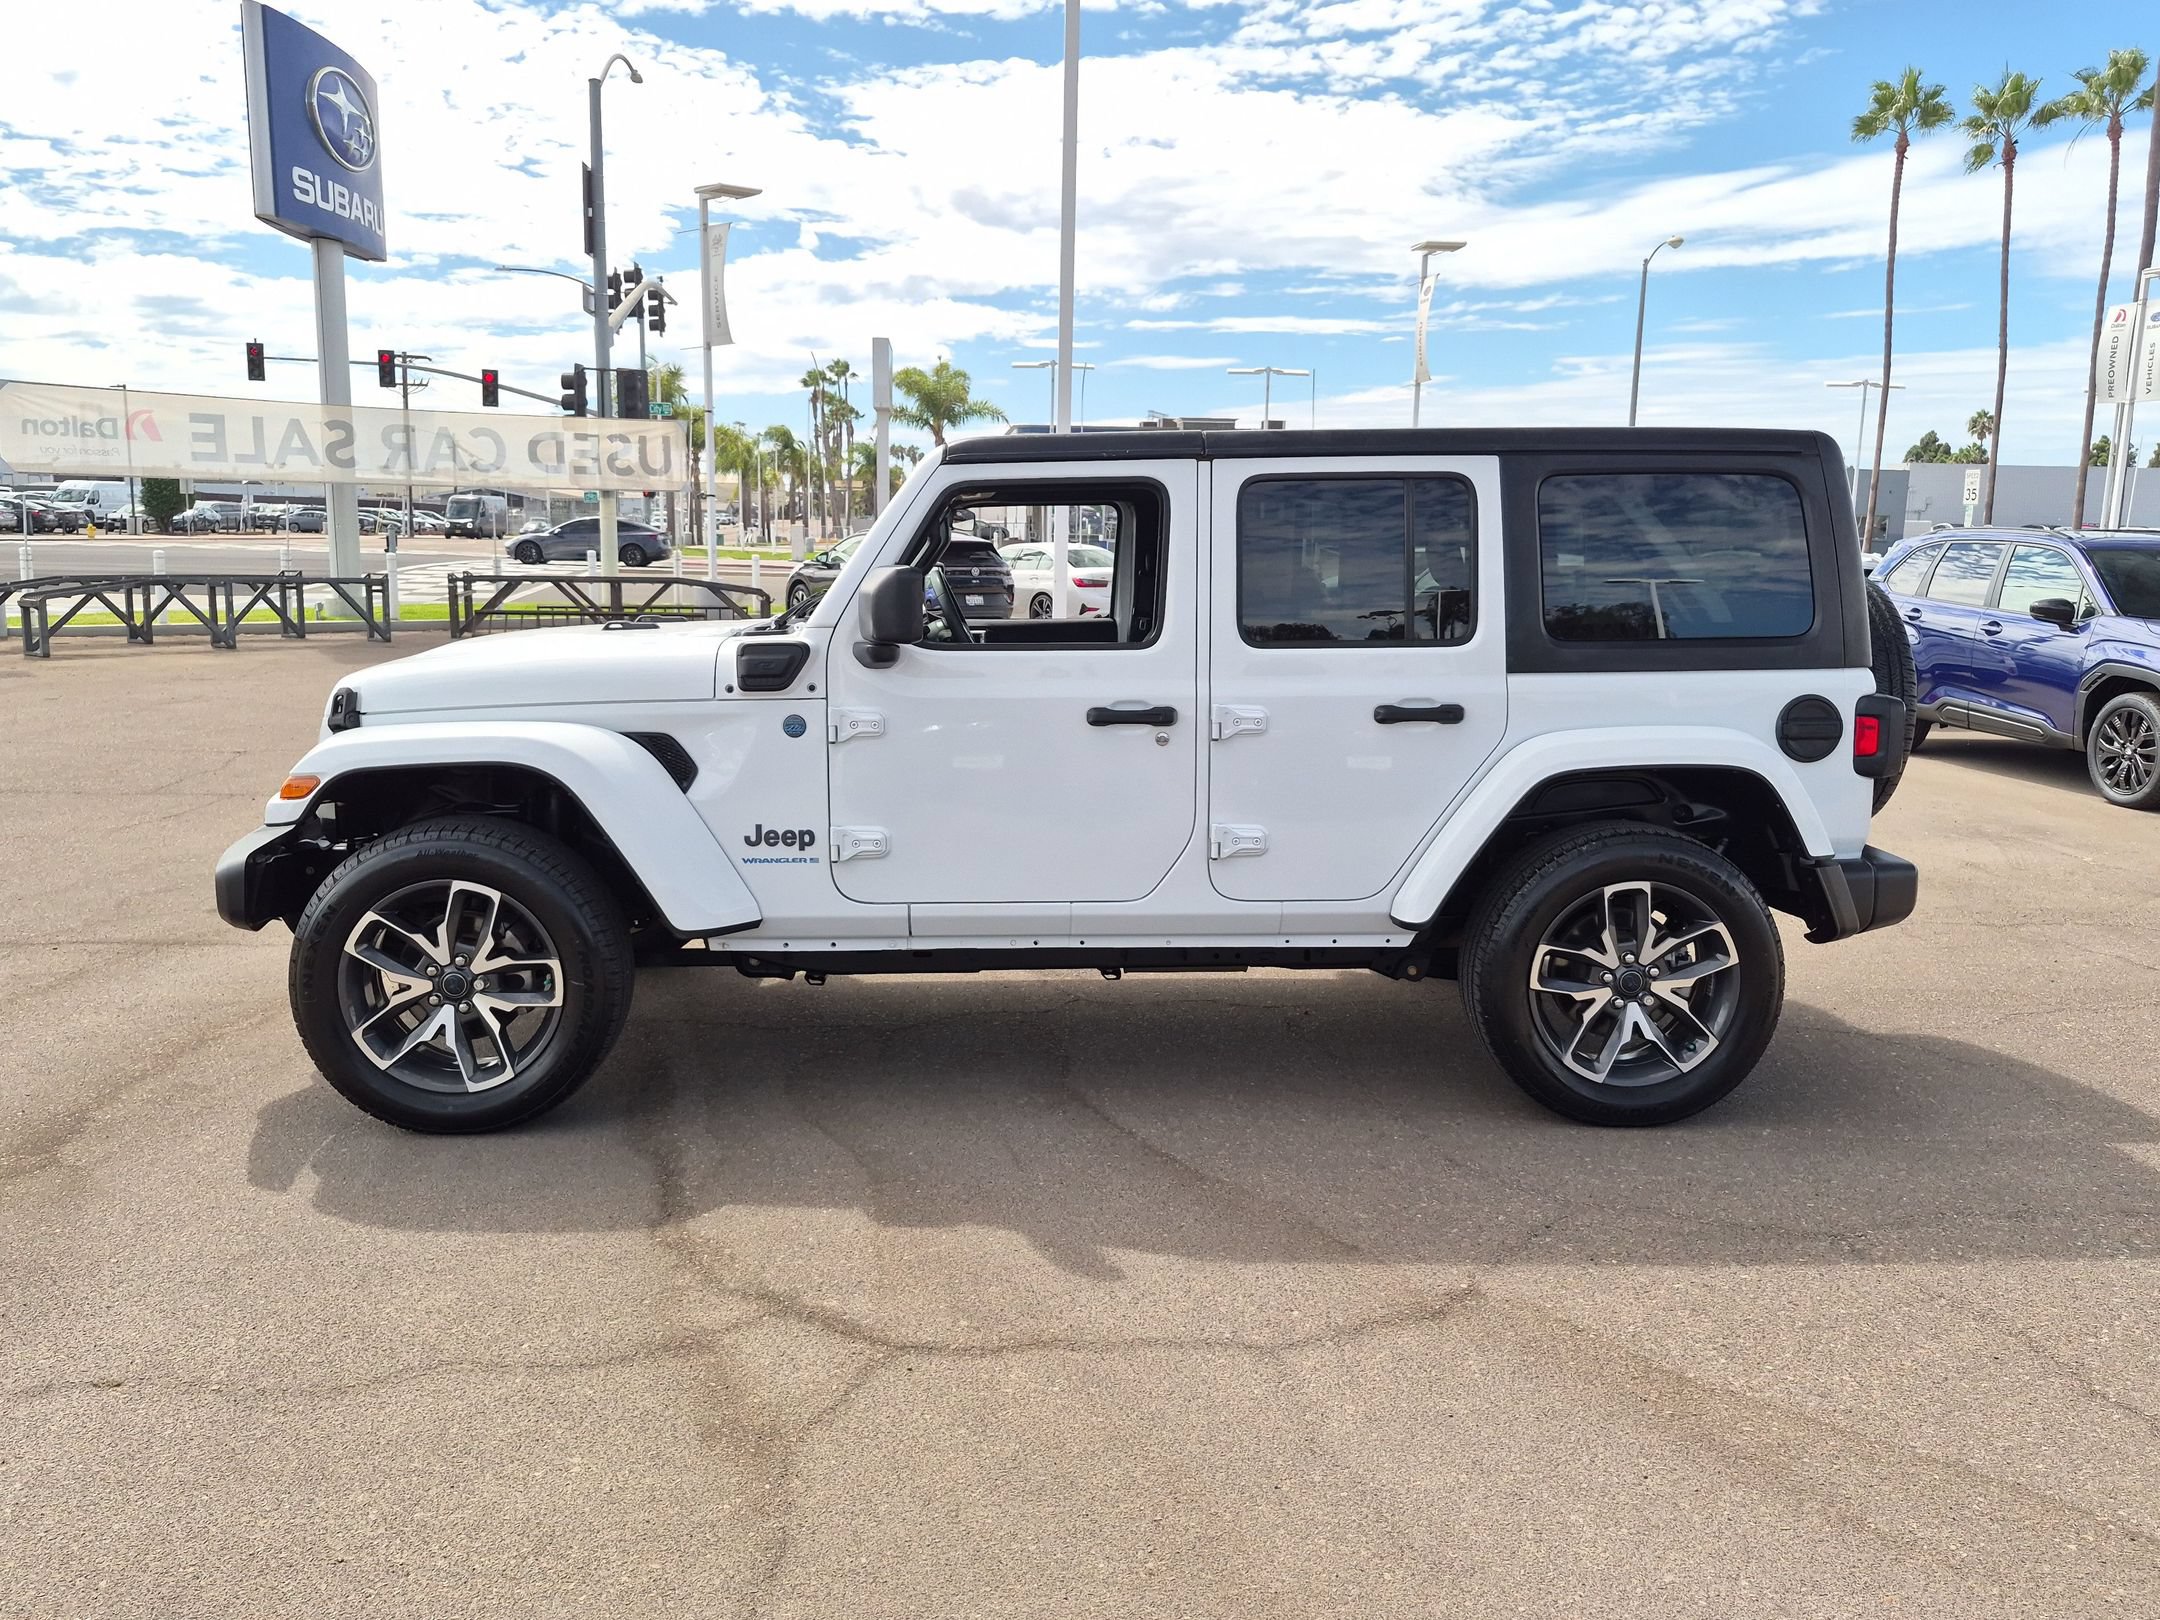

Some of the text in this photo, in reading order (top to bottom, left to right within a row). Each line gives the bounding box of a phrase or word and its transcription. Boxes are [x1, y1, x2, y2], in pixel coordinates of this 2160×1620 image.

[292, 166, 384, 237] SUBARU
[2107, 335, 2119, 398] PREOWNED
[2145, 342, 2156, 395] VEHICLES
[1965, 488, 1977, 501] 35
[744, 824, 815, 851] Jeep
[1658, 853, 1736, 897] NEXEN
[302, 904, 338, 989] NEXEN
